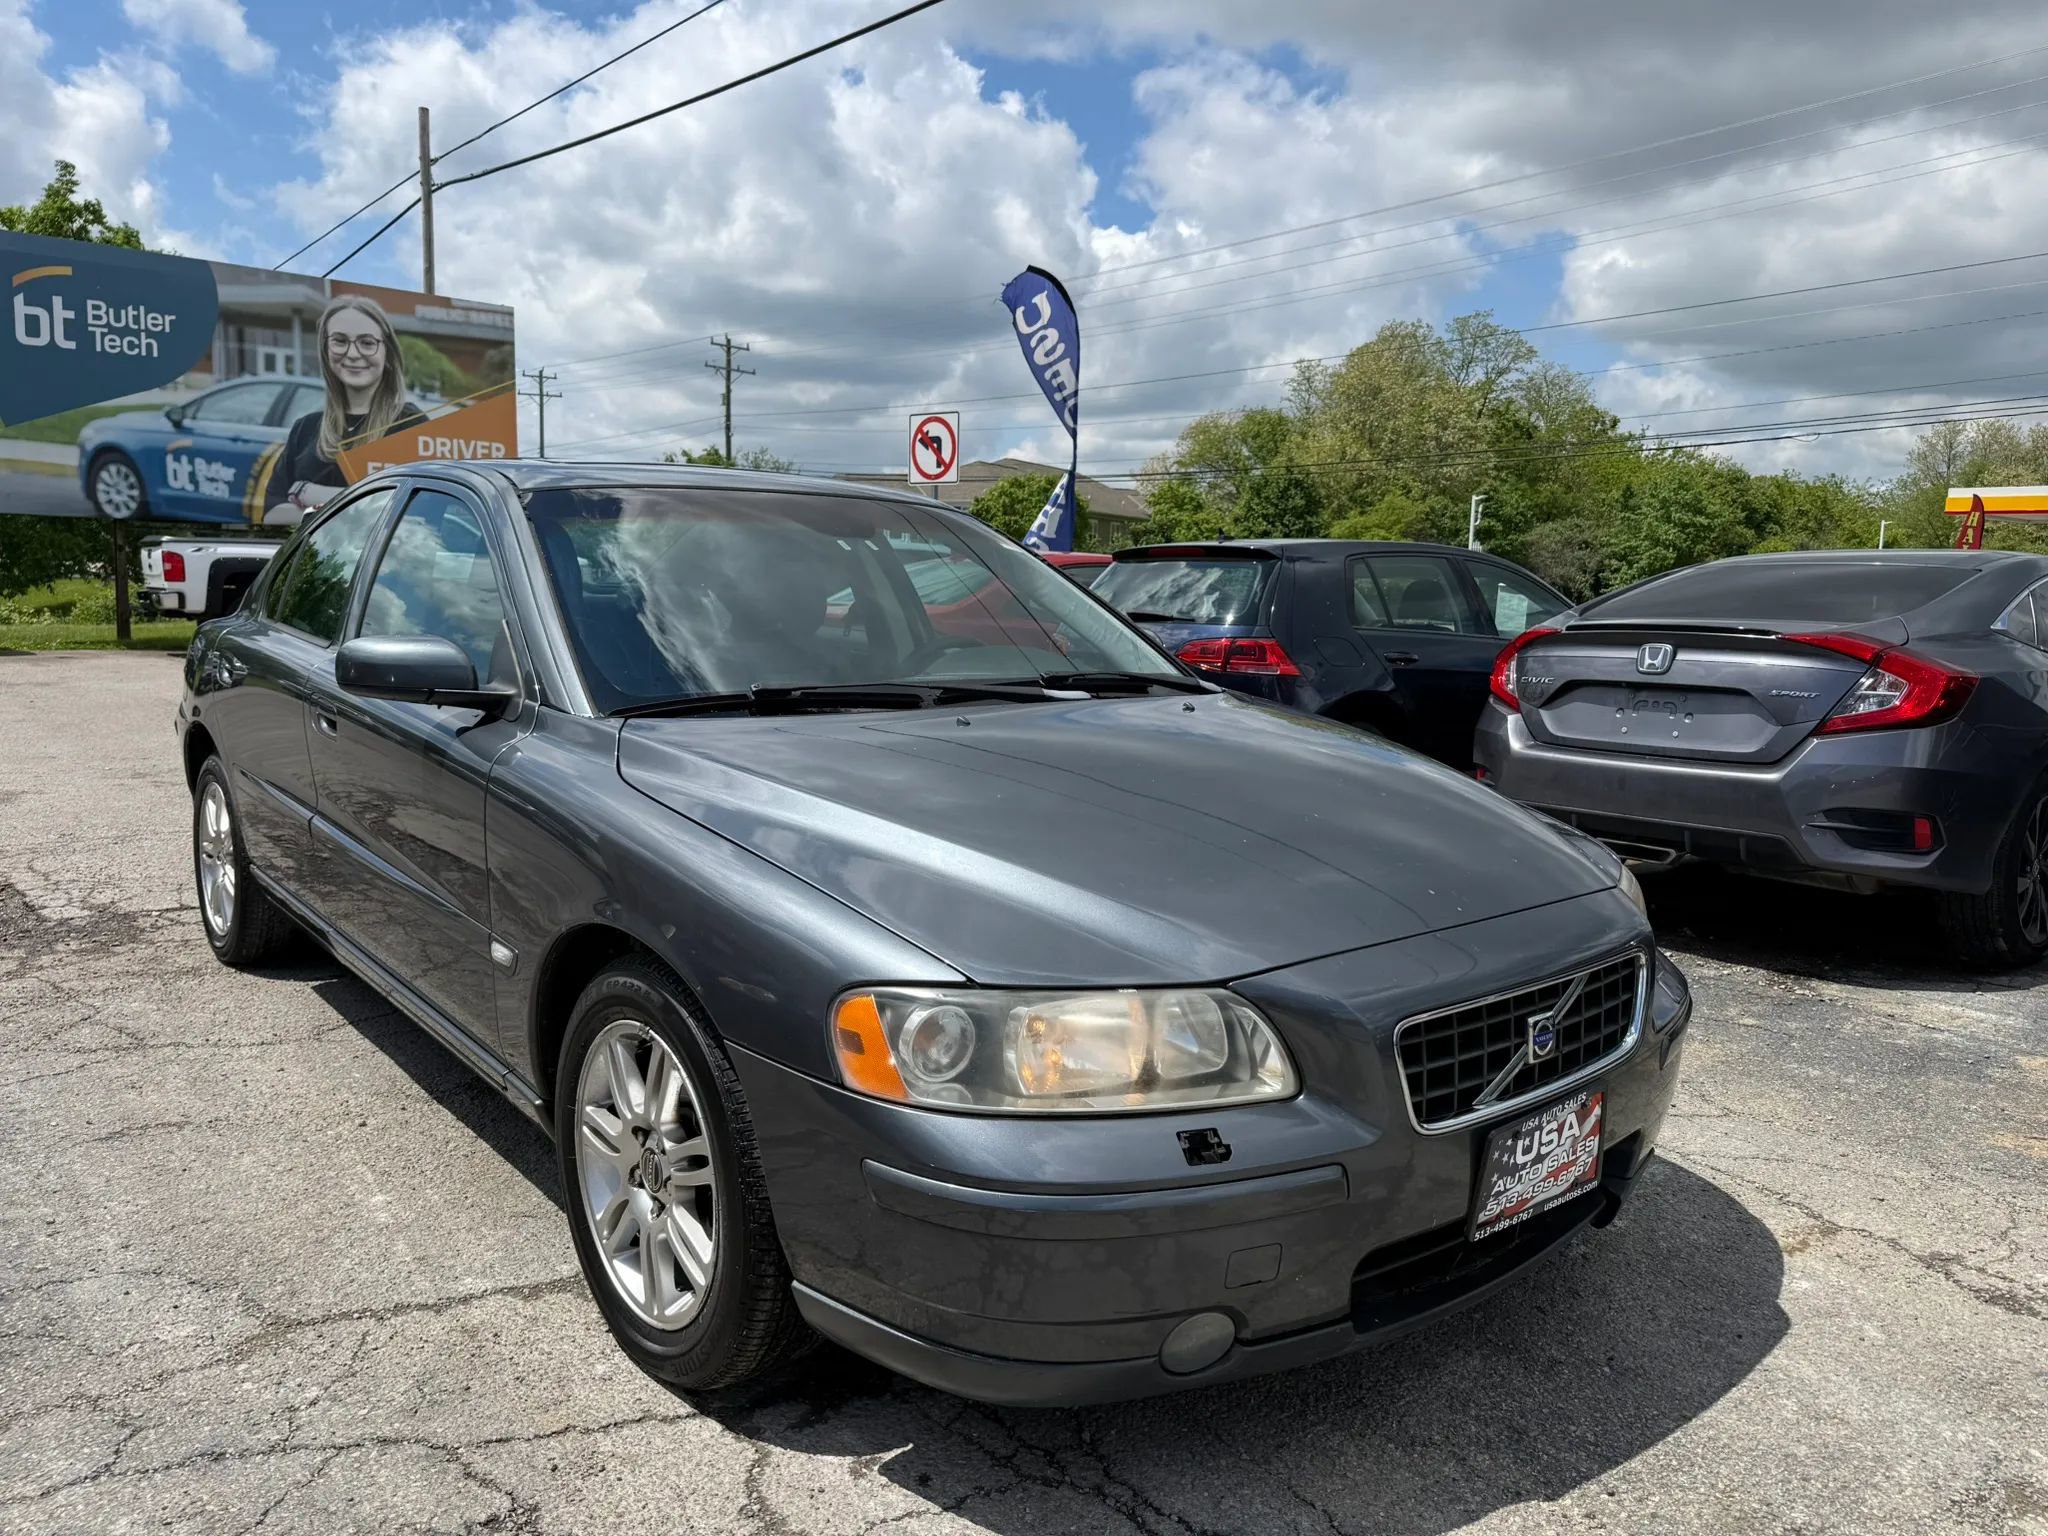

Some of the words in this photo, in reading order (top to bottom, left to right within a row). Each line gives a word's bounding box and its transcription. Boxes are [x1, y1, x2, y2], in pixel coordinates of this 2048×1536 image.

[13, 291, 77, 350] bt
[86, 298, 177, 333] Butler
[87, 326, 159, 358] Tech
[417, 435, 506, 459] DRIVER
[1520, 675, 1556, 684] CIVIC
[1768, 689, 1821, 698] SPORT
[1521, 1116, 1539, 1132] USA
[1540, 1104, 1563, 1127] AUTO
[1563, 1091, 1587, 1111] SALES
[1515, 1111, 1582, 1165] USA
[1490, 1162, 1543, 1196] AUTO
[1546, 1135, 1596, 1172] SALES
[1473, 1208, 1534, 1242] 513-499-6767
